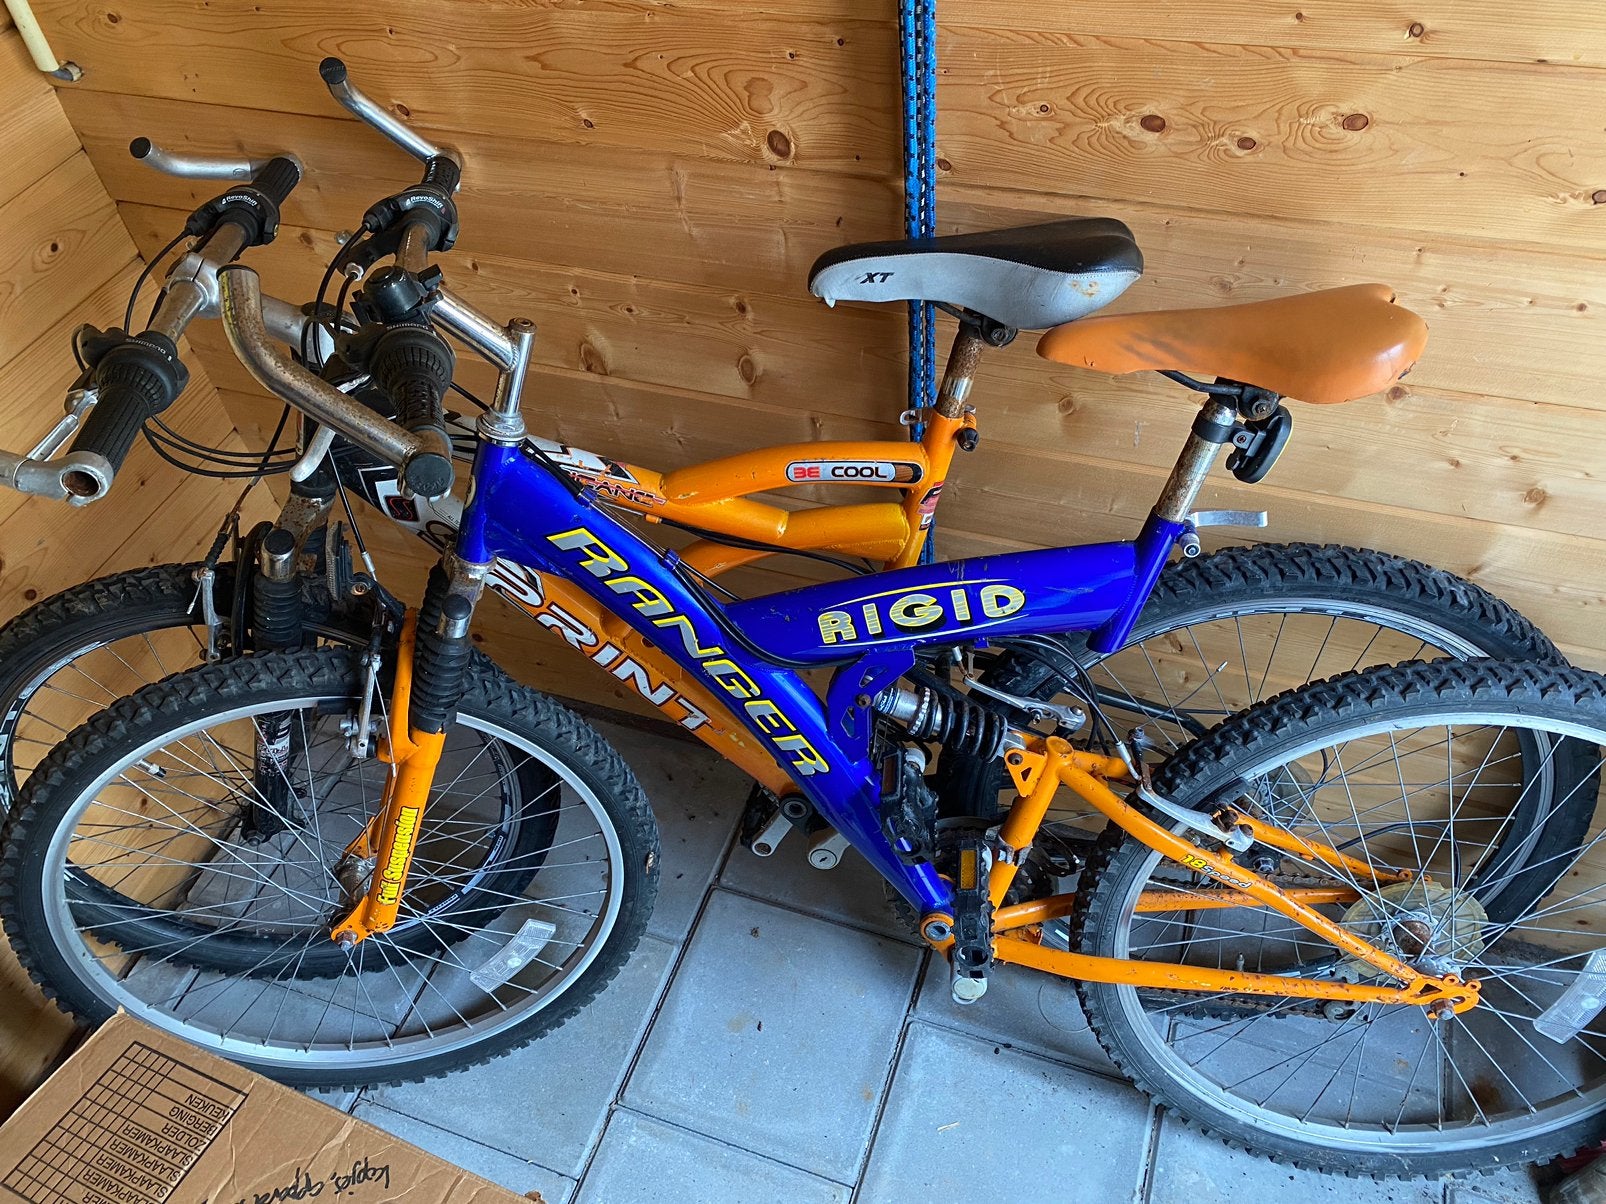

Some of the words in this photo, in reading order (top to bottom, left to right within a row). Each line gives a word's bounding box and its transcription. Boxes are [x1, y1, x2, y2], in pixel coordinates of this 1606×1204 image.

[410, 195, 443, 208] RevoShift
[859, 271, 895, 285] XT
[793, 466, 821, 479] BE
[831, 466, 888, 479] COOL
[817, 583, 1026, 645] RIGID
[545, 526, 832, 778] RANGER
[382, 805, 420, 882] Suspension
[376, 880, 401, 905] Full
[168, 1105, 218, 1137] BERGING
[184, 1093, 231, 1122] KEUKEN
[121, 1123, 193, 1167] SLAAPKAMER
[161, 1122, 207, 1150] ZOLDER
[94, 1153, 168, 1199] SLAAPKAMER
[109, 1138, 181, 1182] SLAAPKAMER
